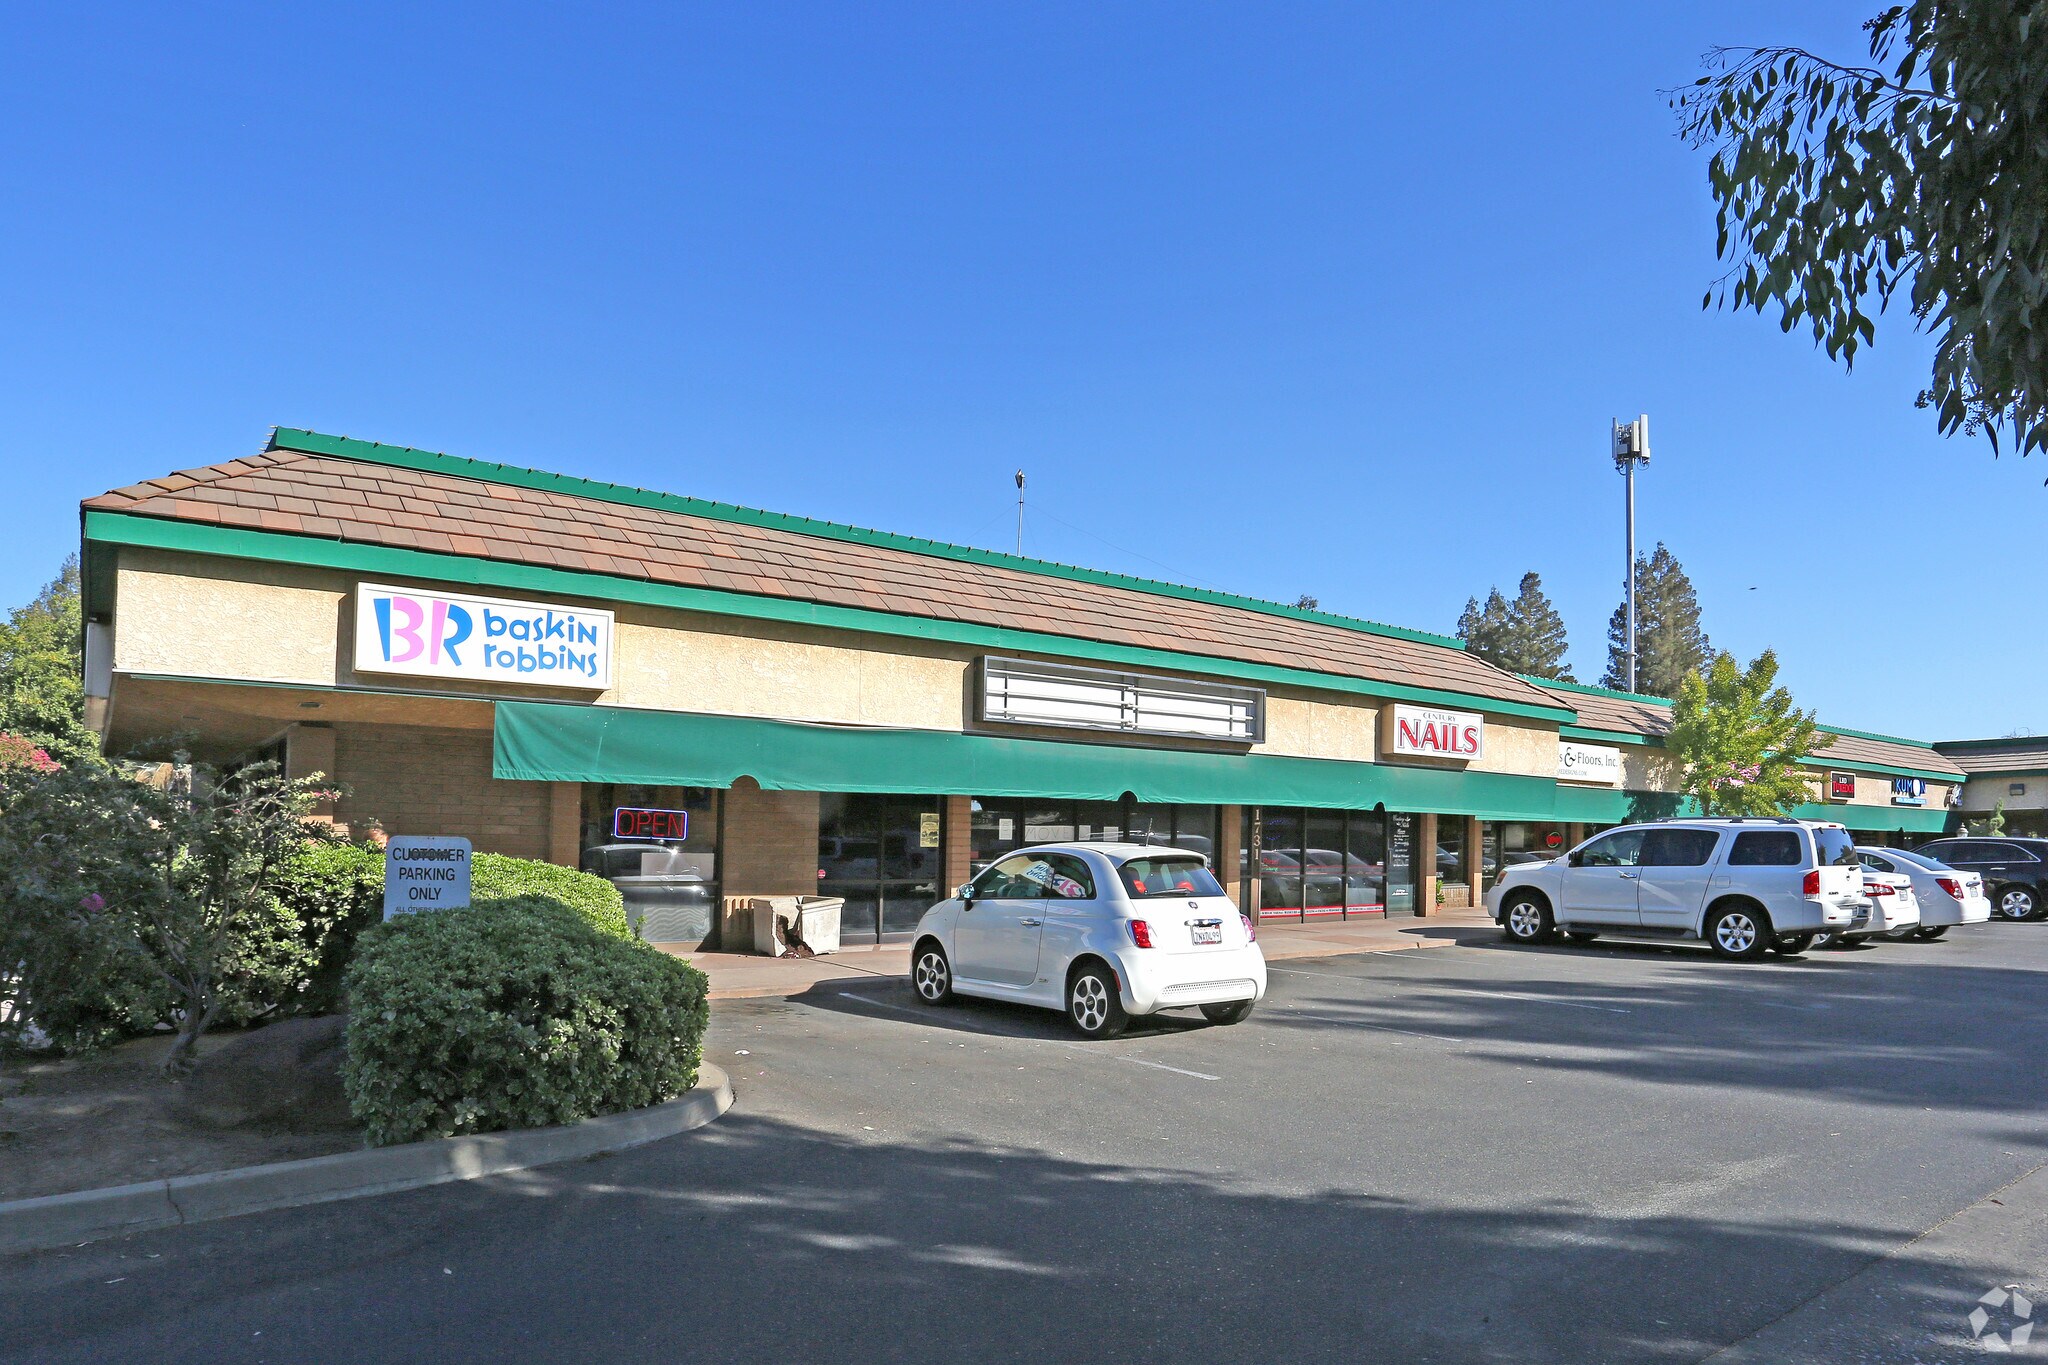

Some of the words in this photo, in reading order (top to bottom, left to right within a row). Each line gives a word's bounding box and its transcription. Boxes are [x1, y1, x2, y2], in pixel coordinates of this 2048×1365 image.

[373, 596, 473, 666] BR
[483, 608, 597, 647] baskin
[484, 643, 597, 678] robbins
[1423, 712, 1456, 722] CENTURY
[1398, 717, 1479, 755] NAILS
[1577, 752, 1604, 766] Floors,
[1606, 755, 1618, 767] Inc.
[1896, 778, 1926, 796] KUMON
[617, 810, 684, 838] OPEN
[399, 867, 455, 881] PARKING
[409, 887, 442, 900] ONLY
